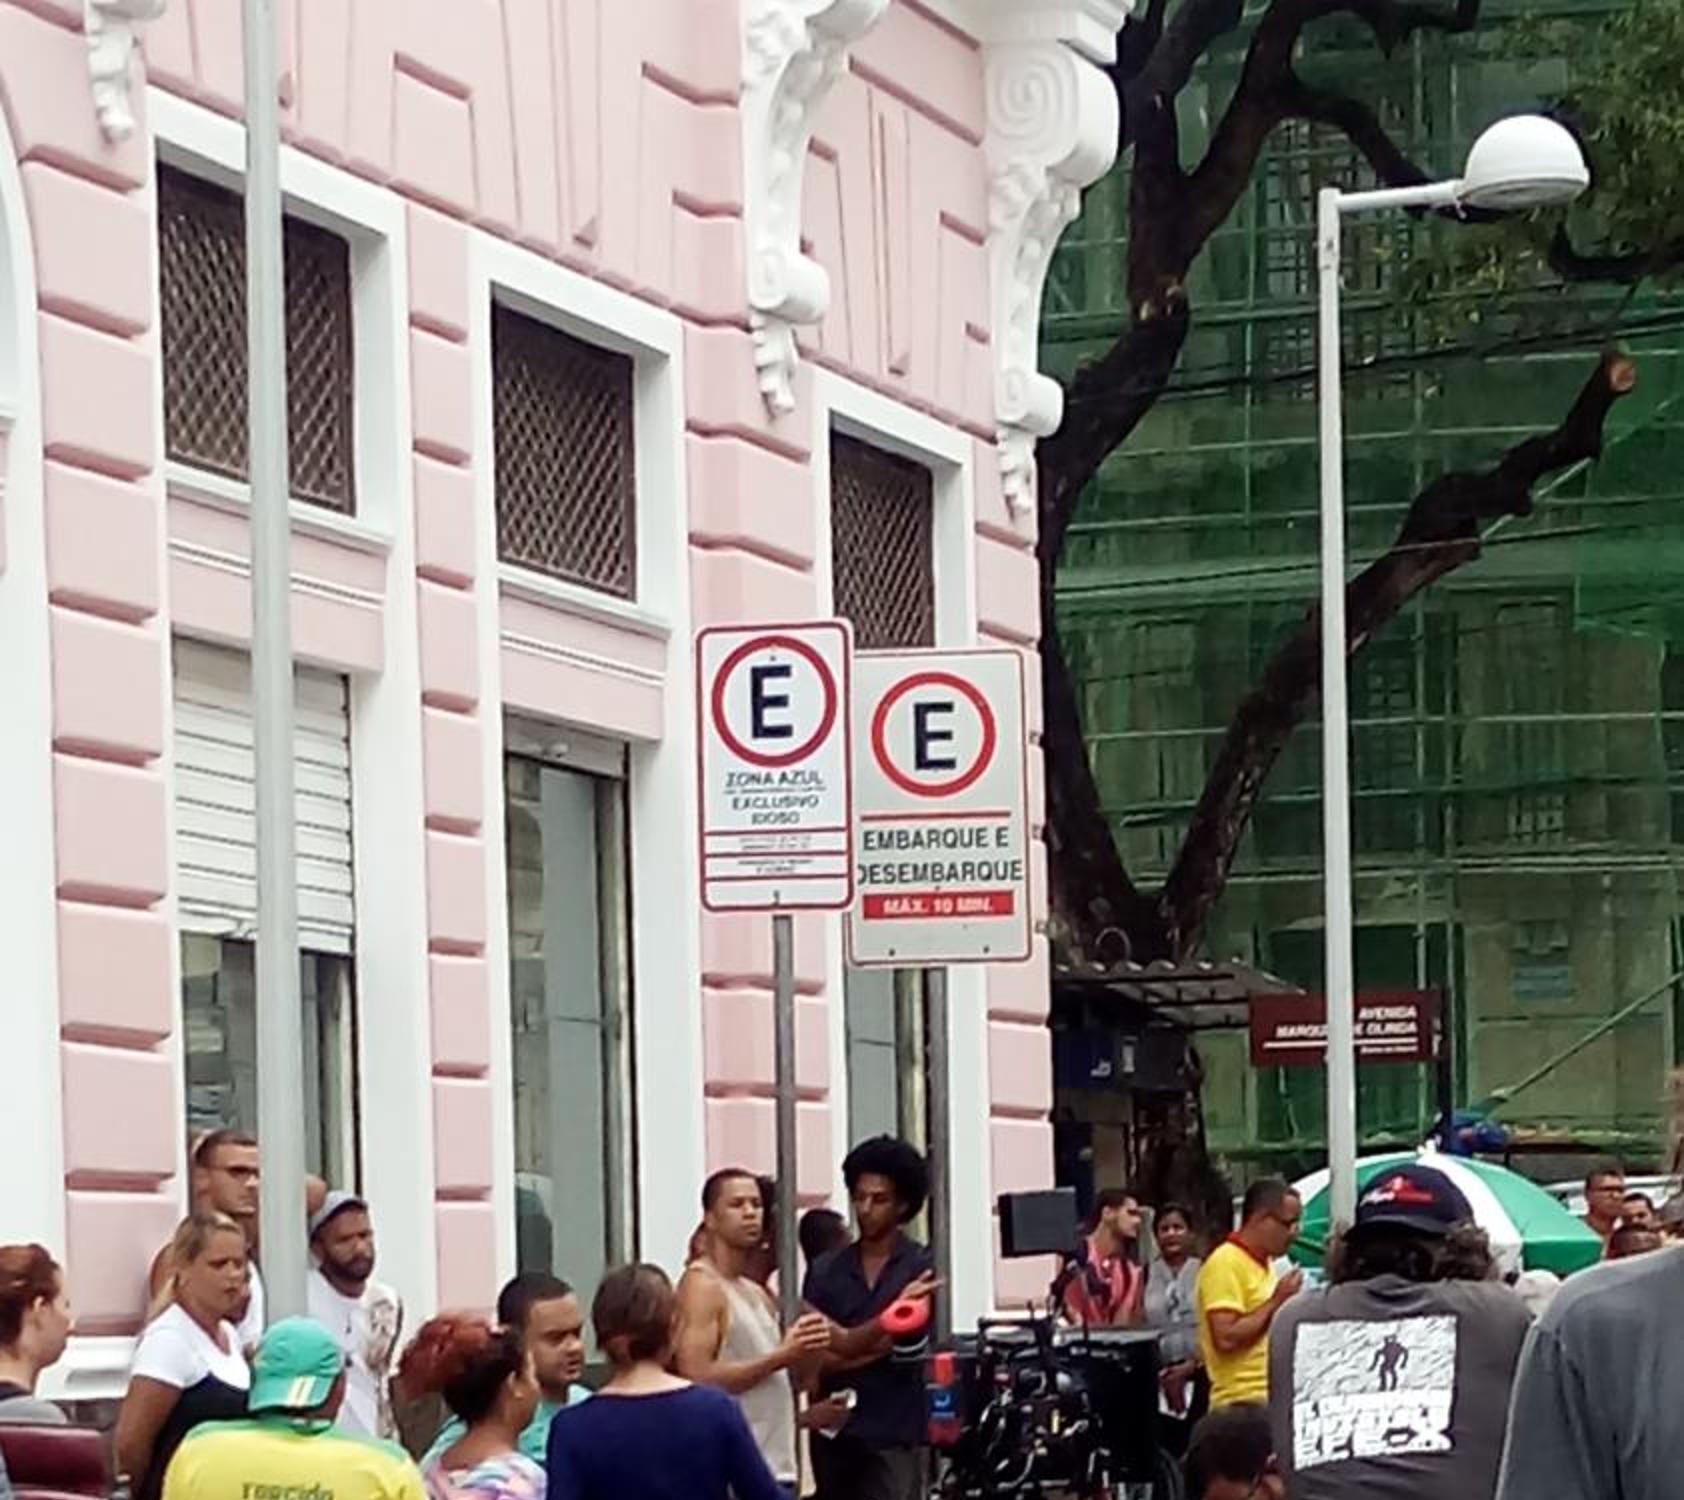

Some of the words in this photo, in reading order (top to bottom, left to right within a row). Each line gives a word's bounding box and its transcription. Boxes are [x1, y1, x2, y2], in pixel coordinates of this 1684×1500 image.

[750, 664, 793, 739] E
[913, 701, 957, 771] E
[726, 772, 774, 788] ZONA
[778, 770, 823, 786] AZUL
[732, 796, 819, 812] EXCLUSIVO
[751, 811, 800, 825] IDOSO
[863, 827, 989, 851] EMBARQUE
[995, 825, 1009, 847] E
[933, 898, 953, 914] 10
[956, 895, 994, 913] MIN.
[1358, 1005, 1418, 1020] AVENIDA
[1366, 1021, 1418, 1036] OLINDA
